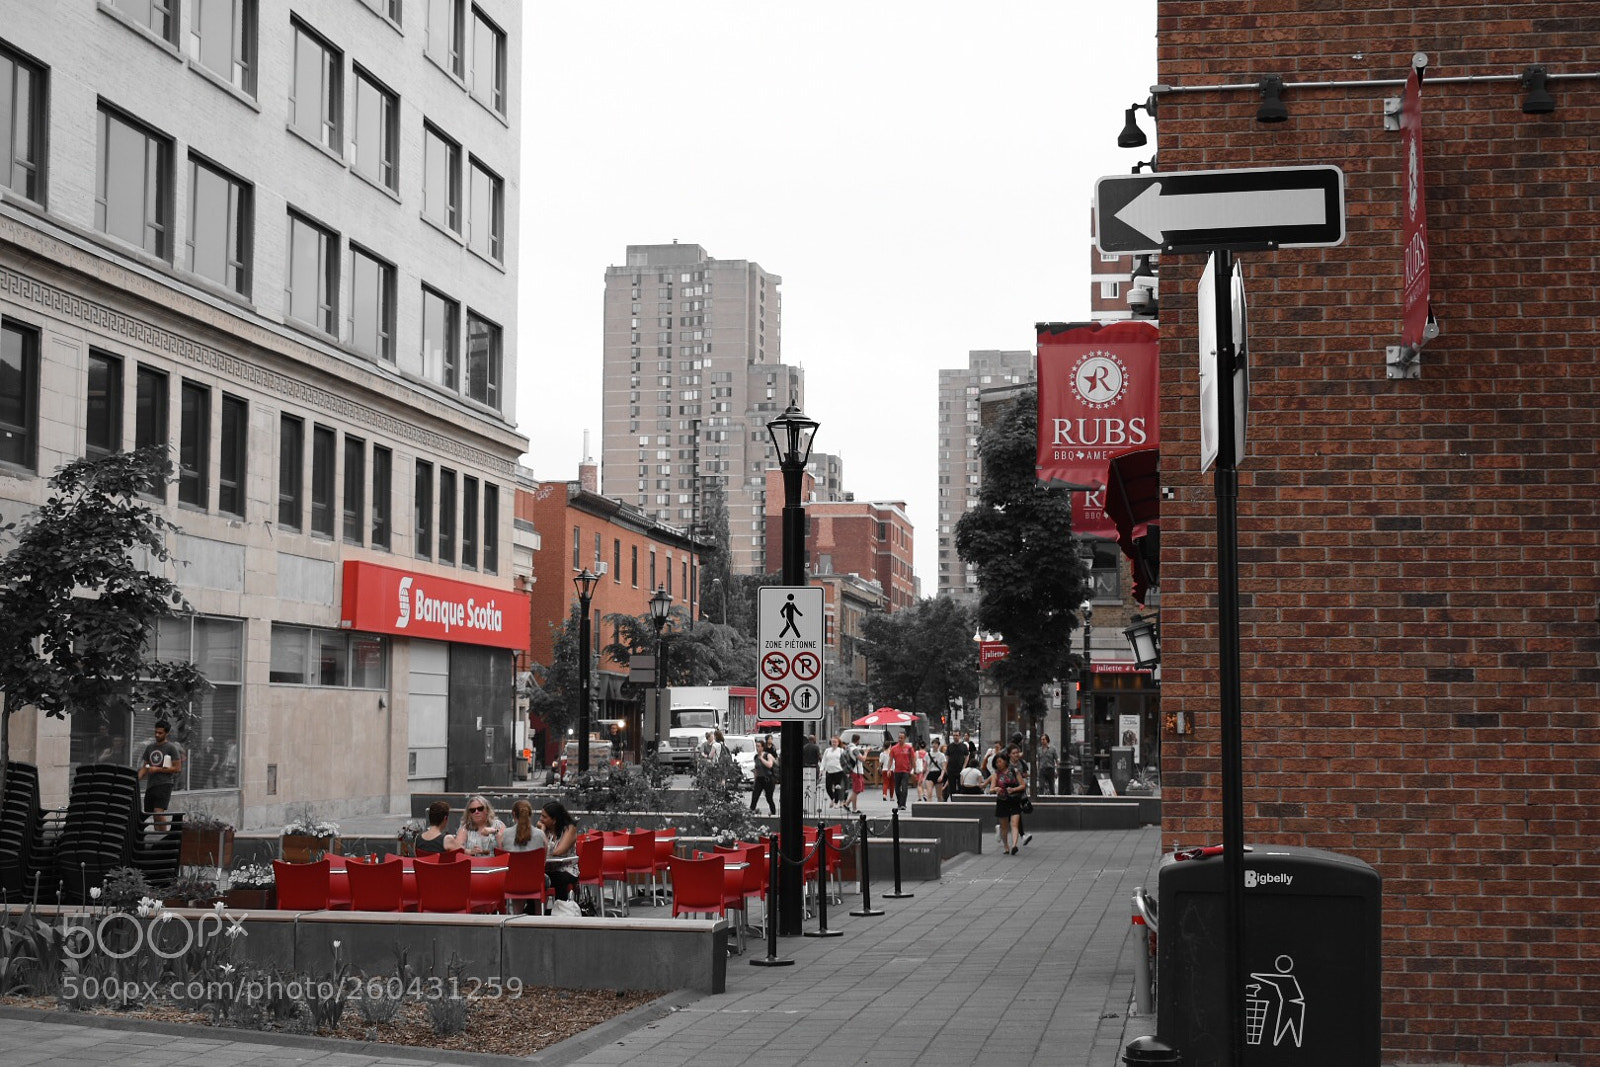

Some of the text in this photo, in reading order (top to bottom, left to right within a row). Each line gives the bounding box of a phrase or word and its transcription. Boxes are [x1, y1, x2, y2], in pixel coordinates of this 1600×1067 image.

[1051, 417, 1147, 445] RUBS
[1054, 450, 1075, 461] BBQ
[415, 588, 503, 633] Banque Scotia
[765, 639, 817, 649] ZONE PIÉTONNE
[1095, 664, 1123, 674] juliette
[1244, 869, 1294, 888] Bigbelly
